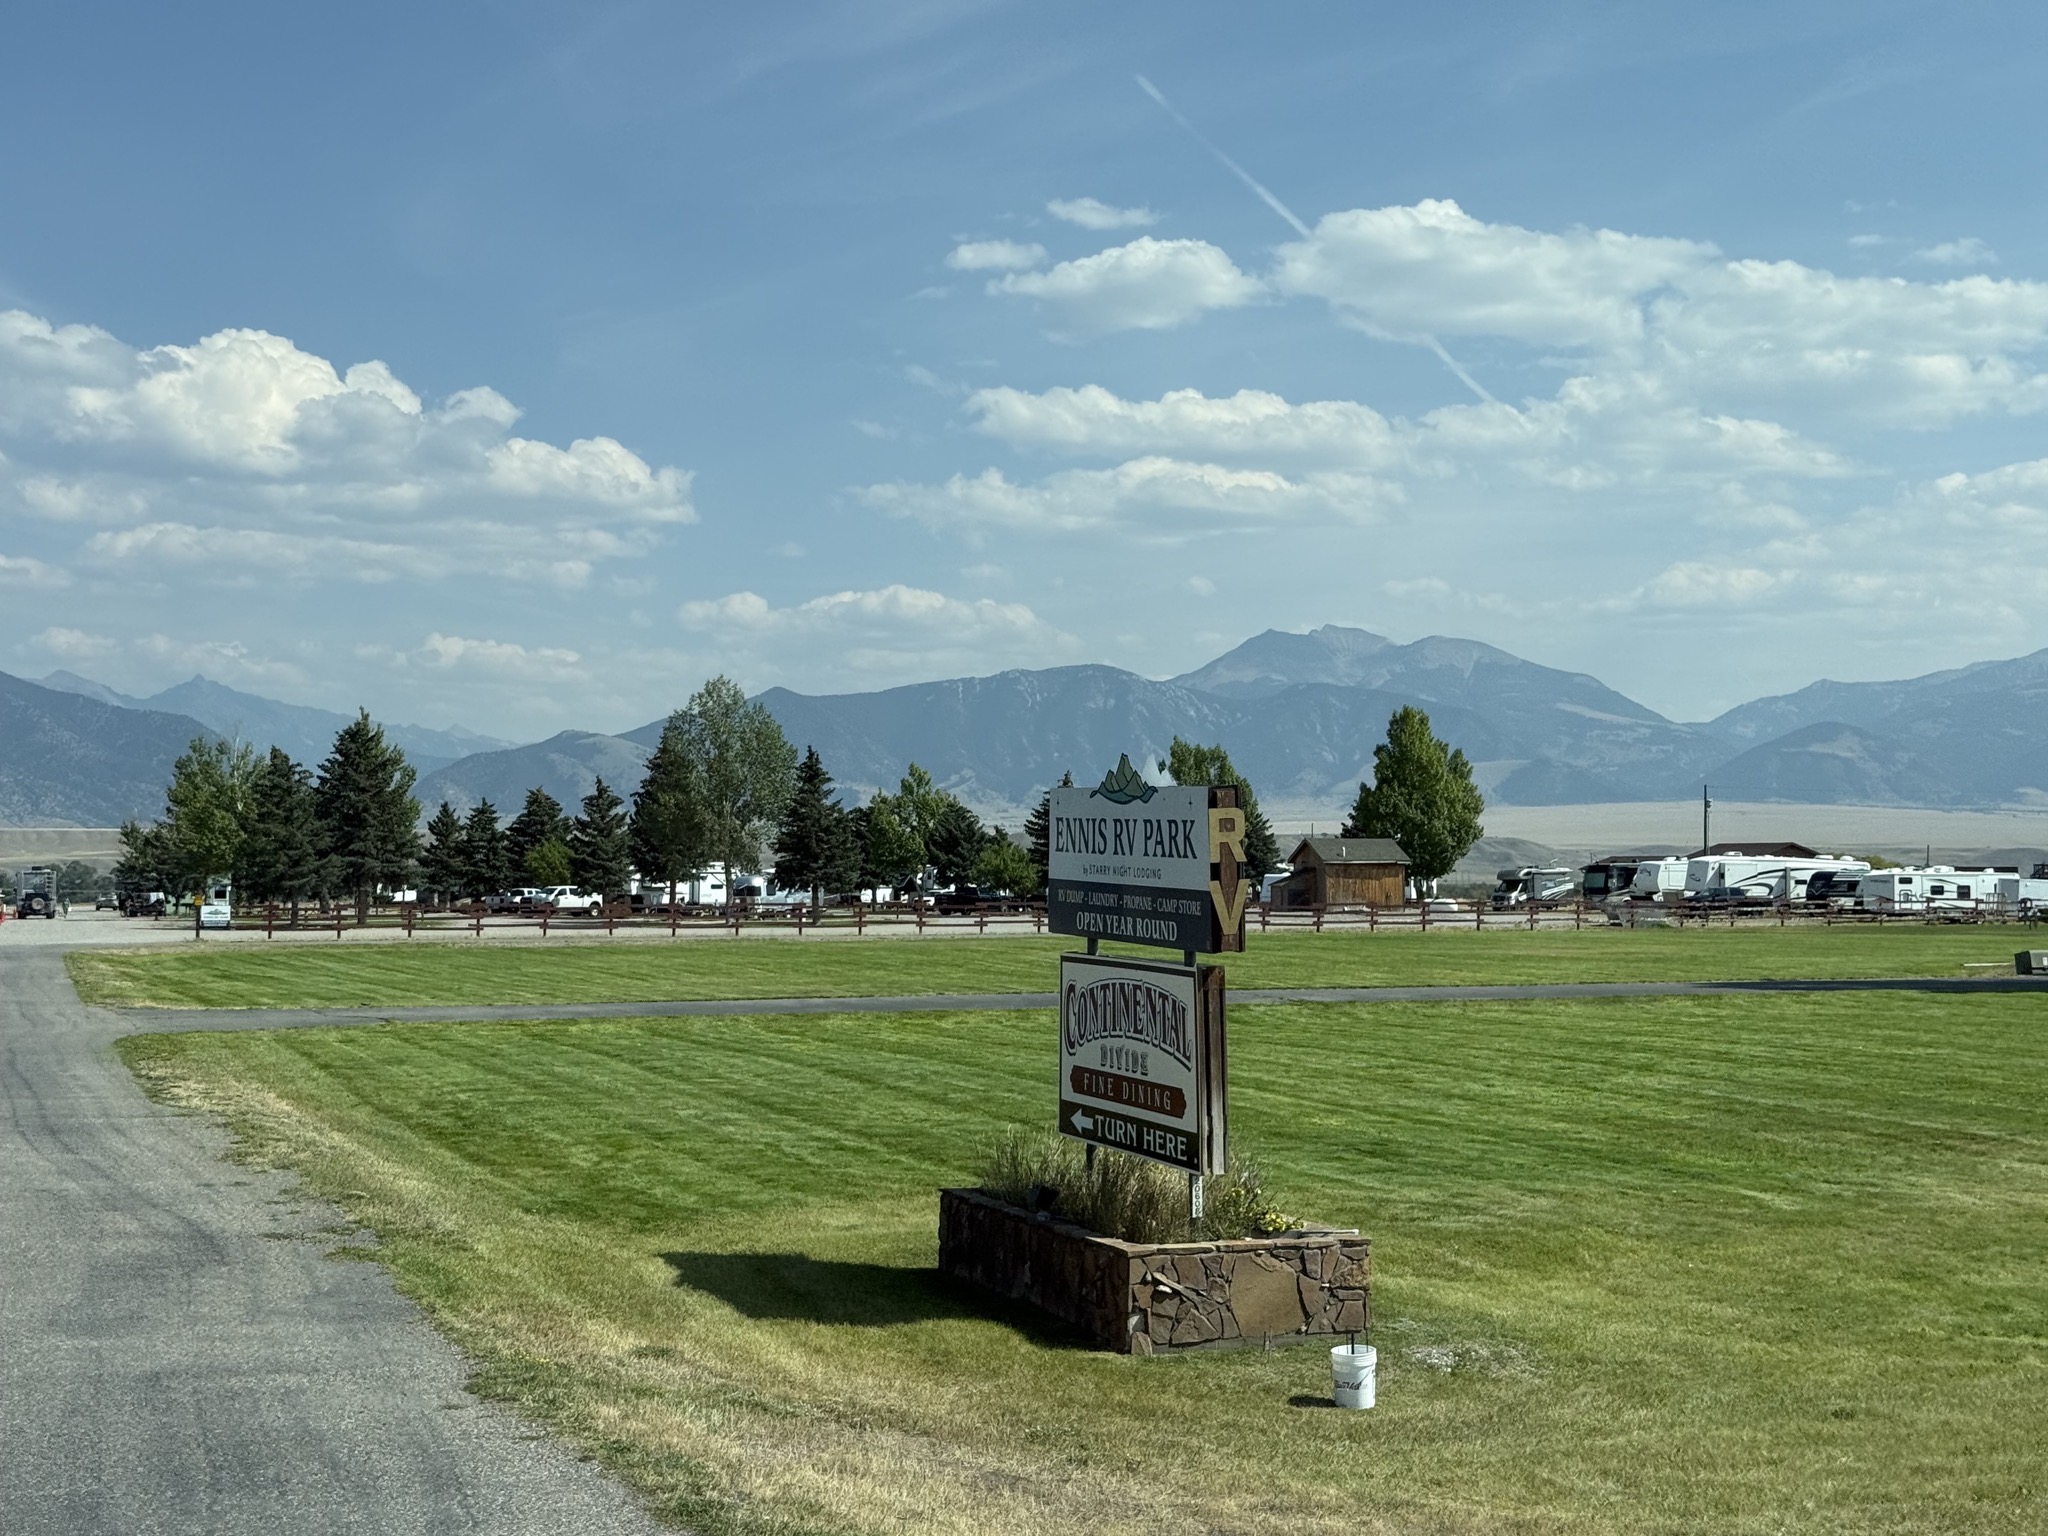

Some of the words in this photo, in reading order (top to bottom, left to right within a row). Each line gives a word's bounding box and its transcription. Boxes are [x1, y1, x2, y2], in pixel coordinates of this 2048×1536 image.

[1055, 816, 1108, 856] ENNIS
[1112, 818, 1138, 857] RV
[1142, 818, 1198, 860] PARK
[1082, 864, 1088, 877] by
[1089, 864, 1111, 876] STARRY
[1113, 865, 1132, 878] NIGHT
[1133, 866, 1162, 880] LODGING
[1058, 889, 1066, 902] RV
[1066, 889, 1085, 904] DUMP
[1088, 891, 1119, 908] LAUNDRY
[1123, 894, 1153, 911] PROPANE
[1157, 898, 1178, 914] CAMP
[1178, 900, 1202, 916] STORE
[1076, 911, 1104, 933] OPEN
[1105, 914, 1134, 937] YEAR
[1136, 917, 1178, 942] ROUND
[1064, 977, 1193, 1073] CONTINENTAL
[1100, 1043, 1149, 1076] DIVIDE
[1083, 1072, 1114, 1097] FINE
[1122, 1081, 1171, 1112] DINING
[1094, 1114, 1138, 1147] TURN
[1142, 1127, 1188, 1161] HERE
